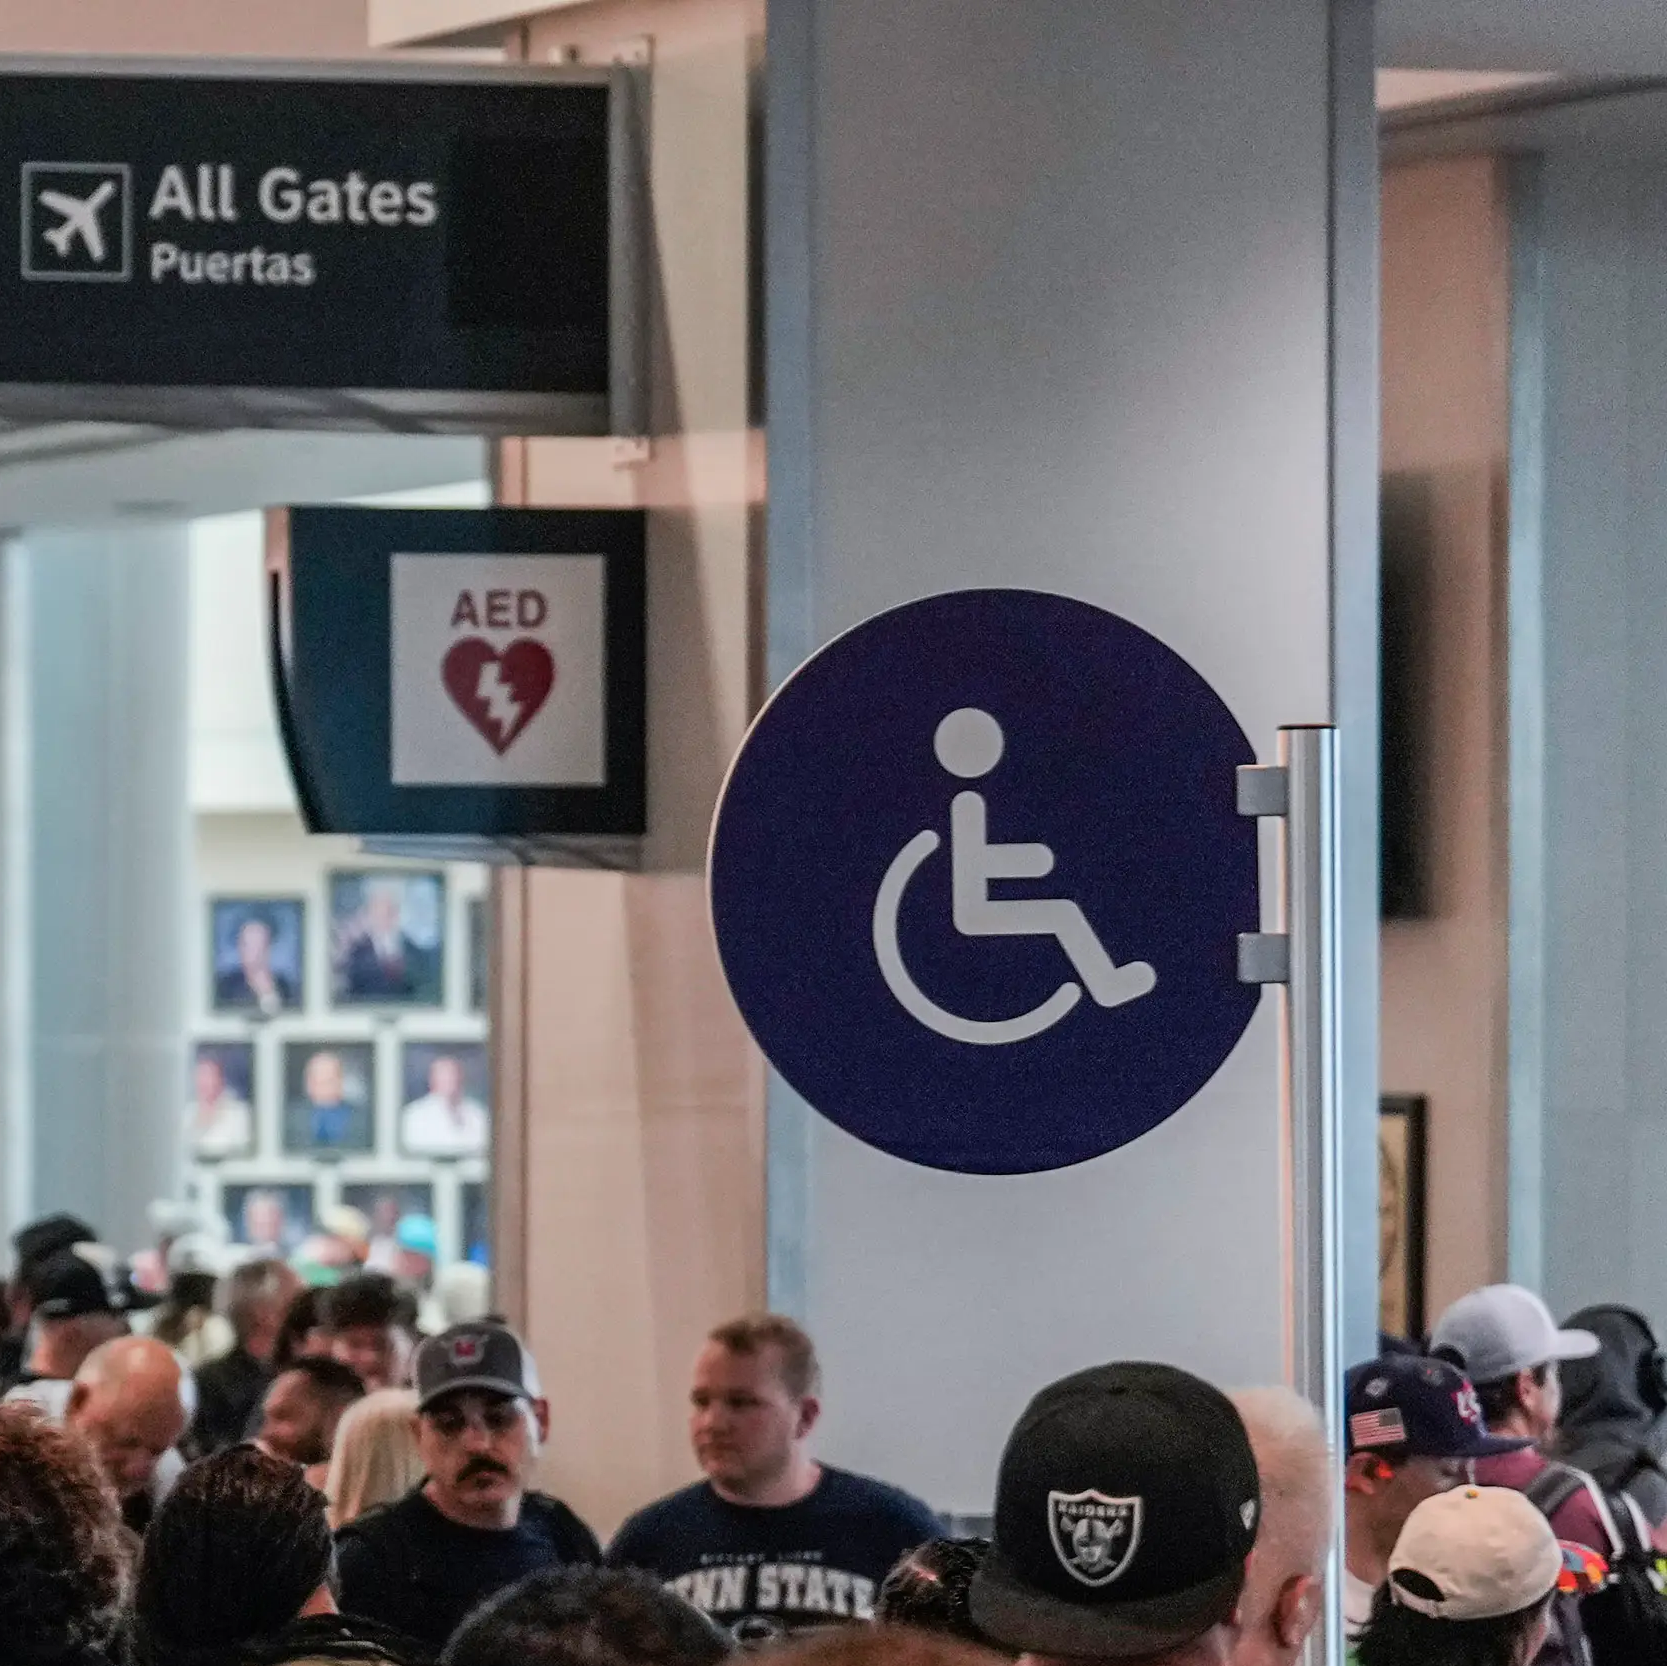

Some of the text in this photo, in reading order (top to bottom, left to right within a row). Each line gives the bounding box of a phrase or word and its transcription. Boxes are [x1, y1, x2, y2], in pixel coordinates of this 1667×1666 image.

[148, 163, 438, 225] All Gates
[150, 241, 316, 285] Puertas
[450, 589, 548, 628] AED
[757, 1562, 875, 1620] STATE
